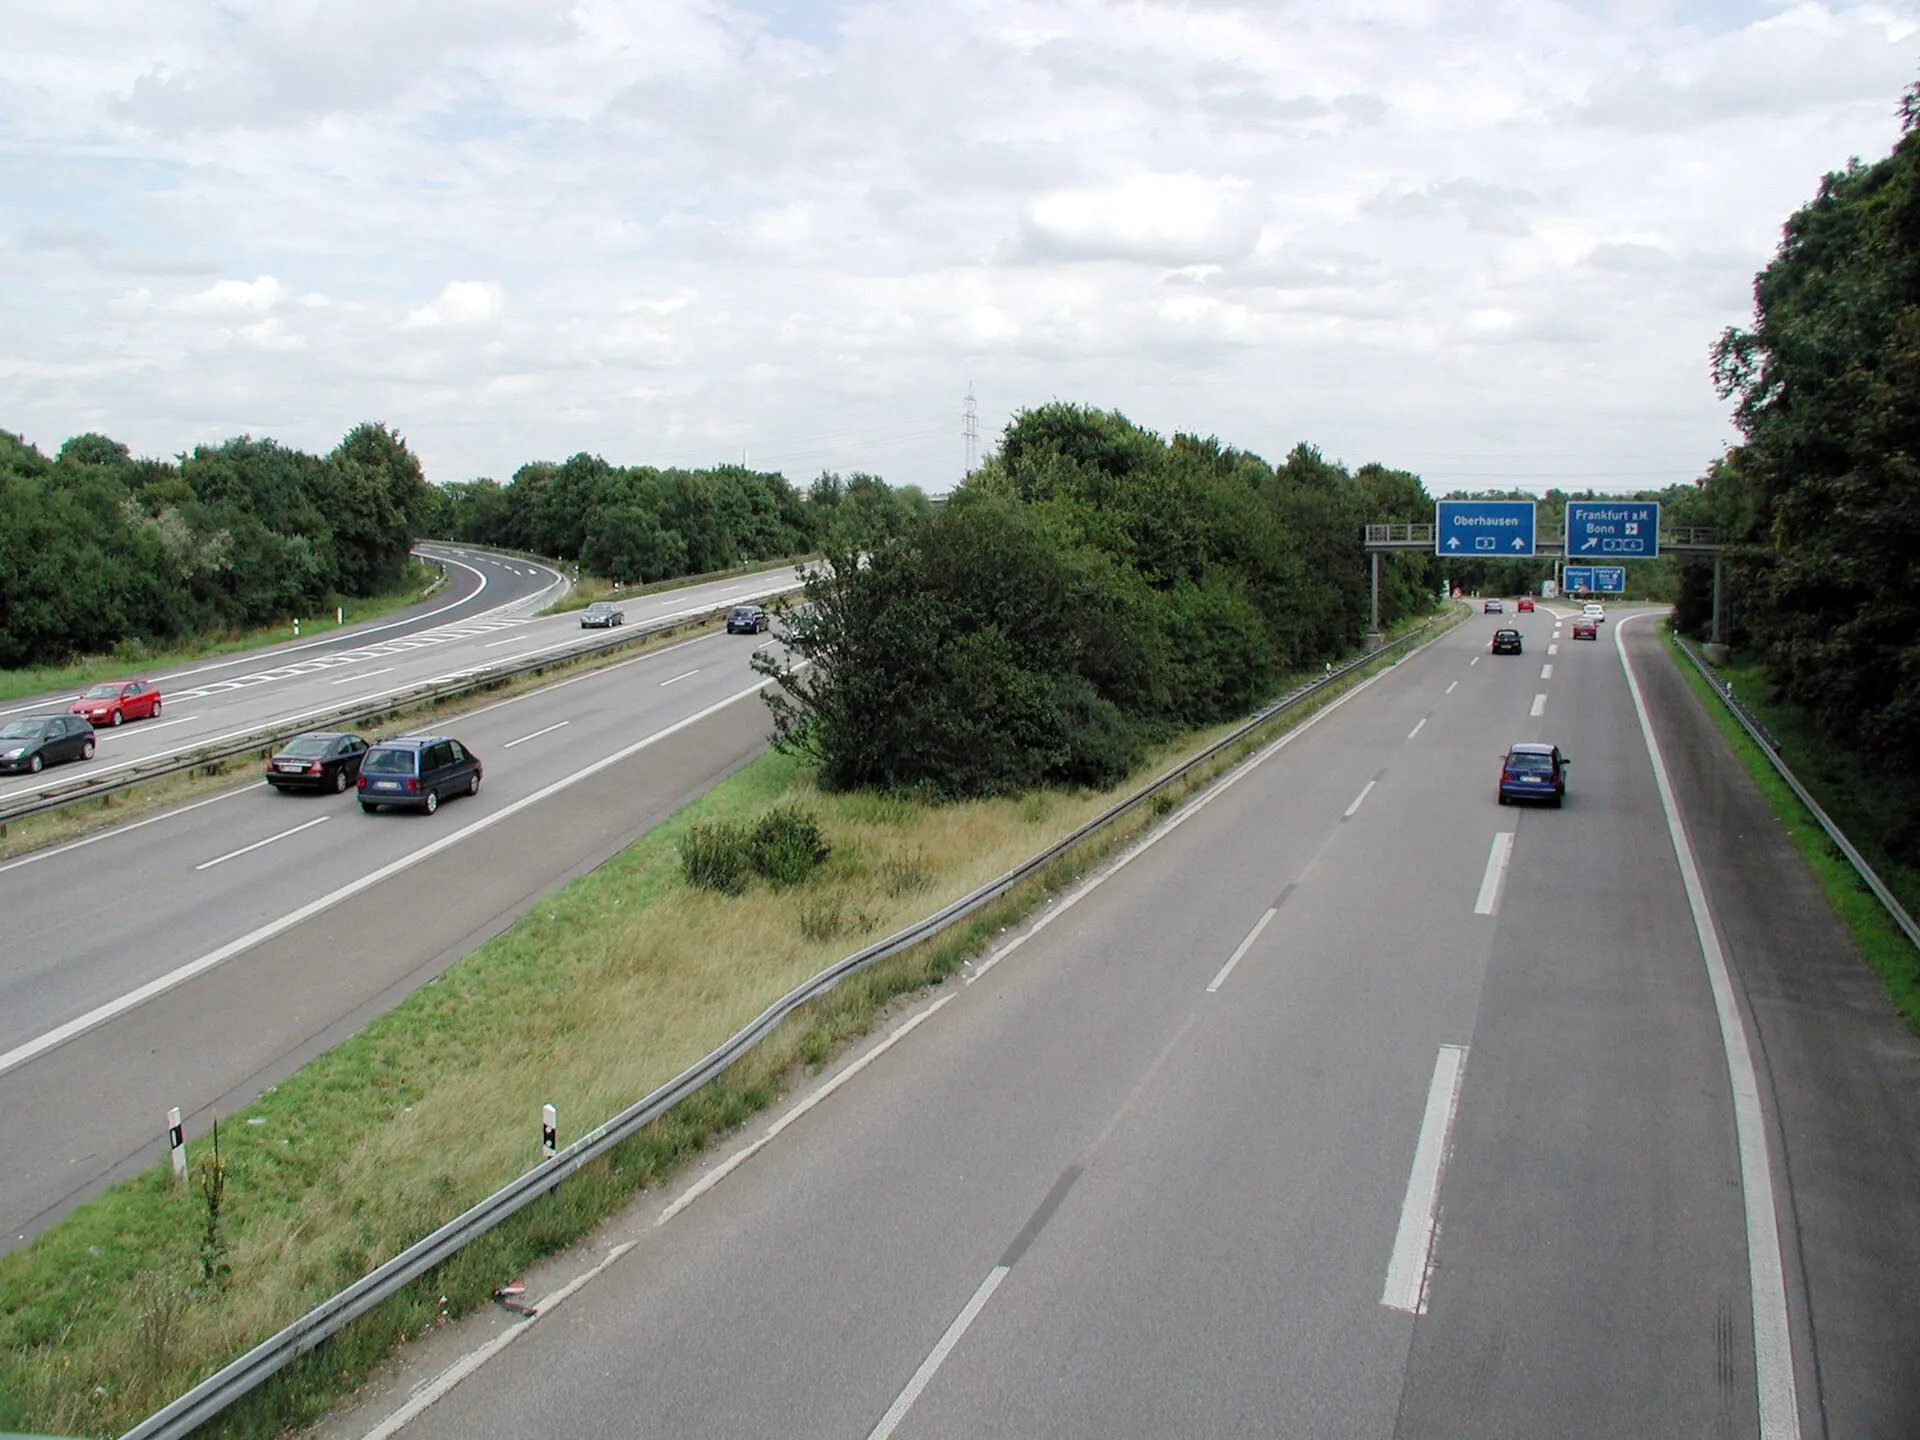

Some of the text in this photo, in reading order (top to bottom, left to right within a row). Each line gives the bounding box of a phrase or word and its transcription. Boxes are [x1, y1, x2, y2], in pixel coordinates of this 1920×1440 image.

[1576, 510, 1629, 520] Frankfurt
[1453, 515, 1518, 526] Oberhausen
[1586, 523, 1615, 533] Bonn
